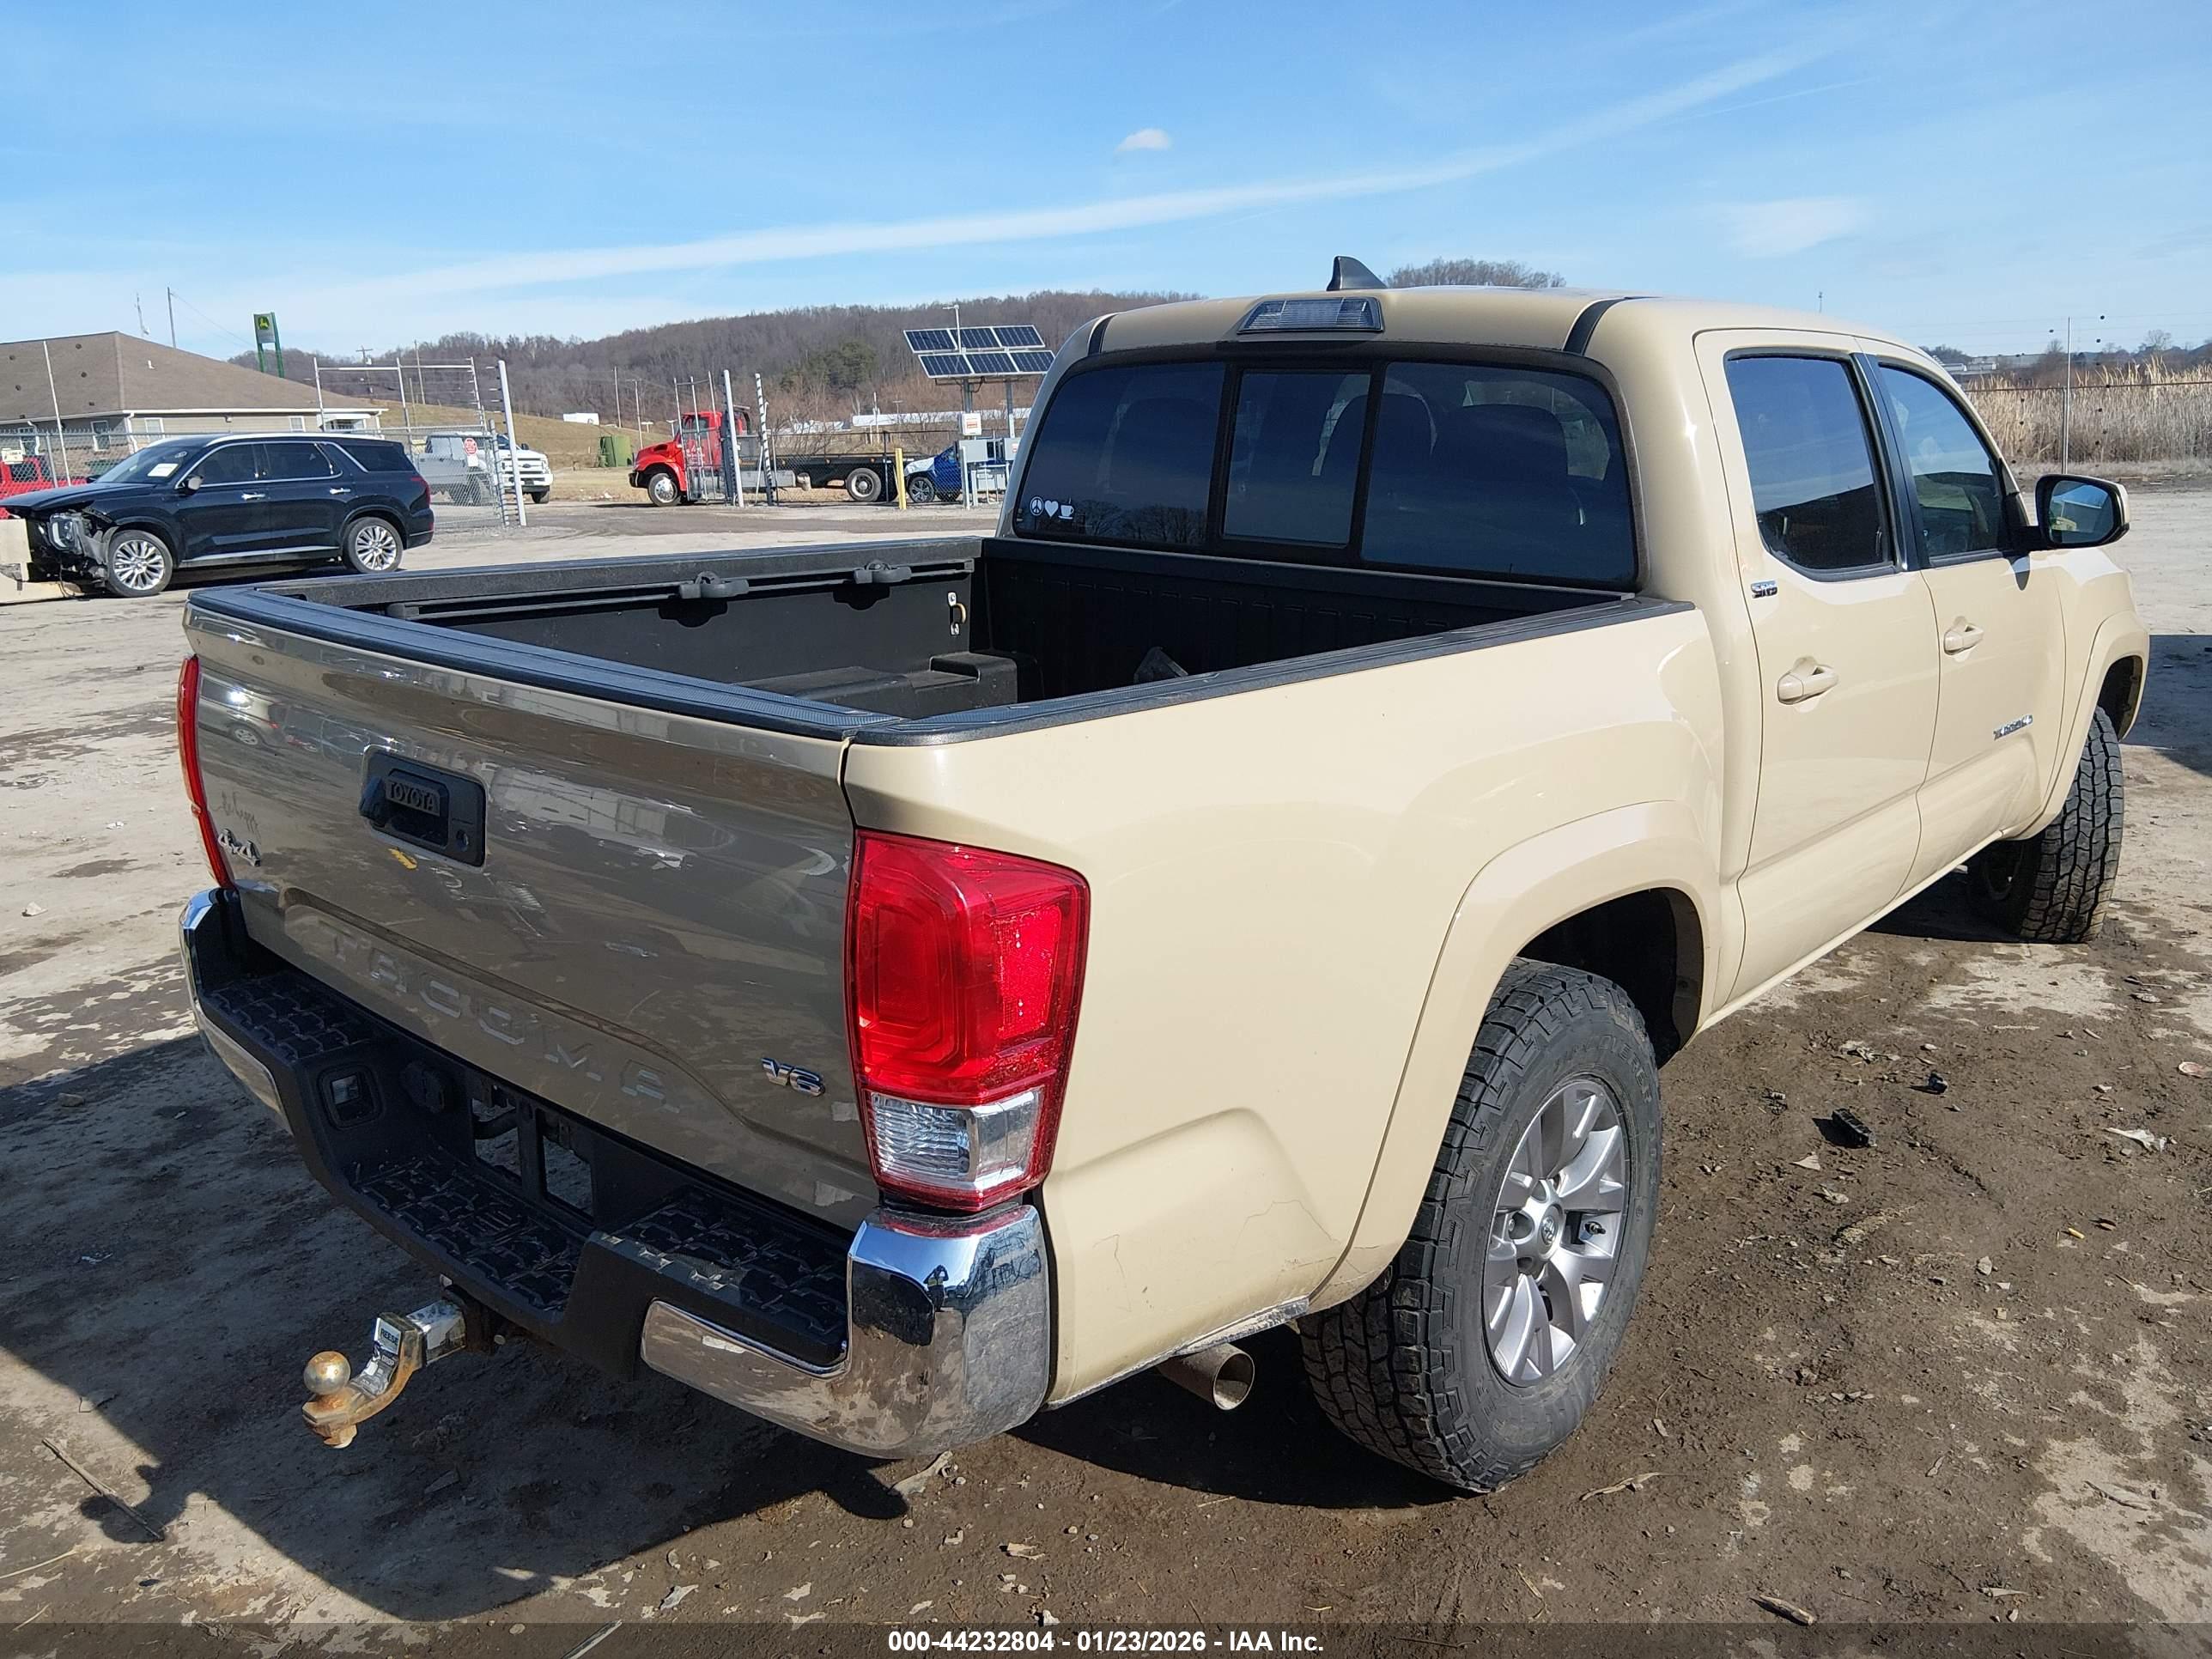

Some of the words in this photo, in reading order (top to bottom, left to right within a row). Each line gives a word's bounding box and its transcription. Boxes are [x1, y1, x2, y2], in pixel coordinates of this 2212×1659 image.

[388, 781, 436, 811] TOYOTA
[319, 921, 681, 1115] TACOMA
[761, 1057, 825, 1097] V6
[380, 1328, 399, 1346] REESE
